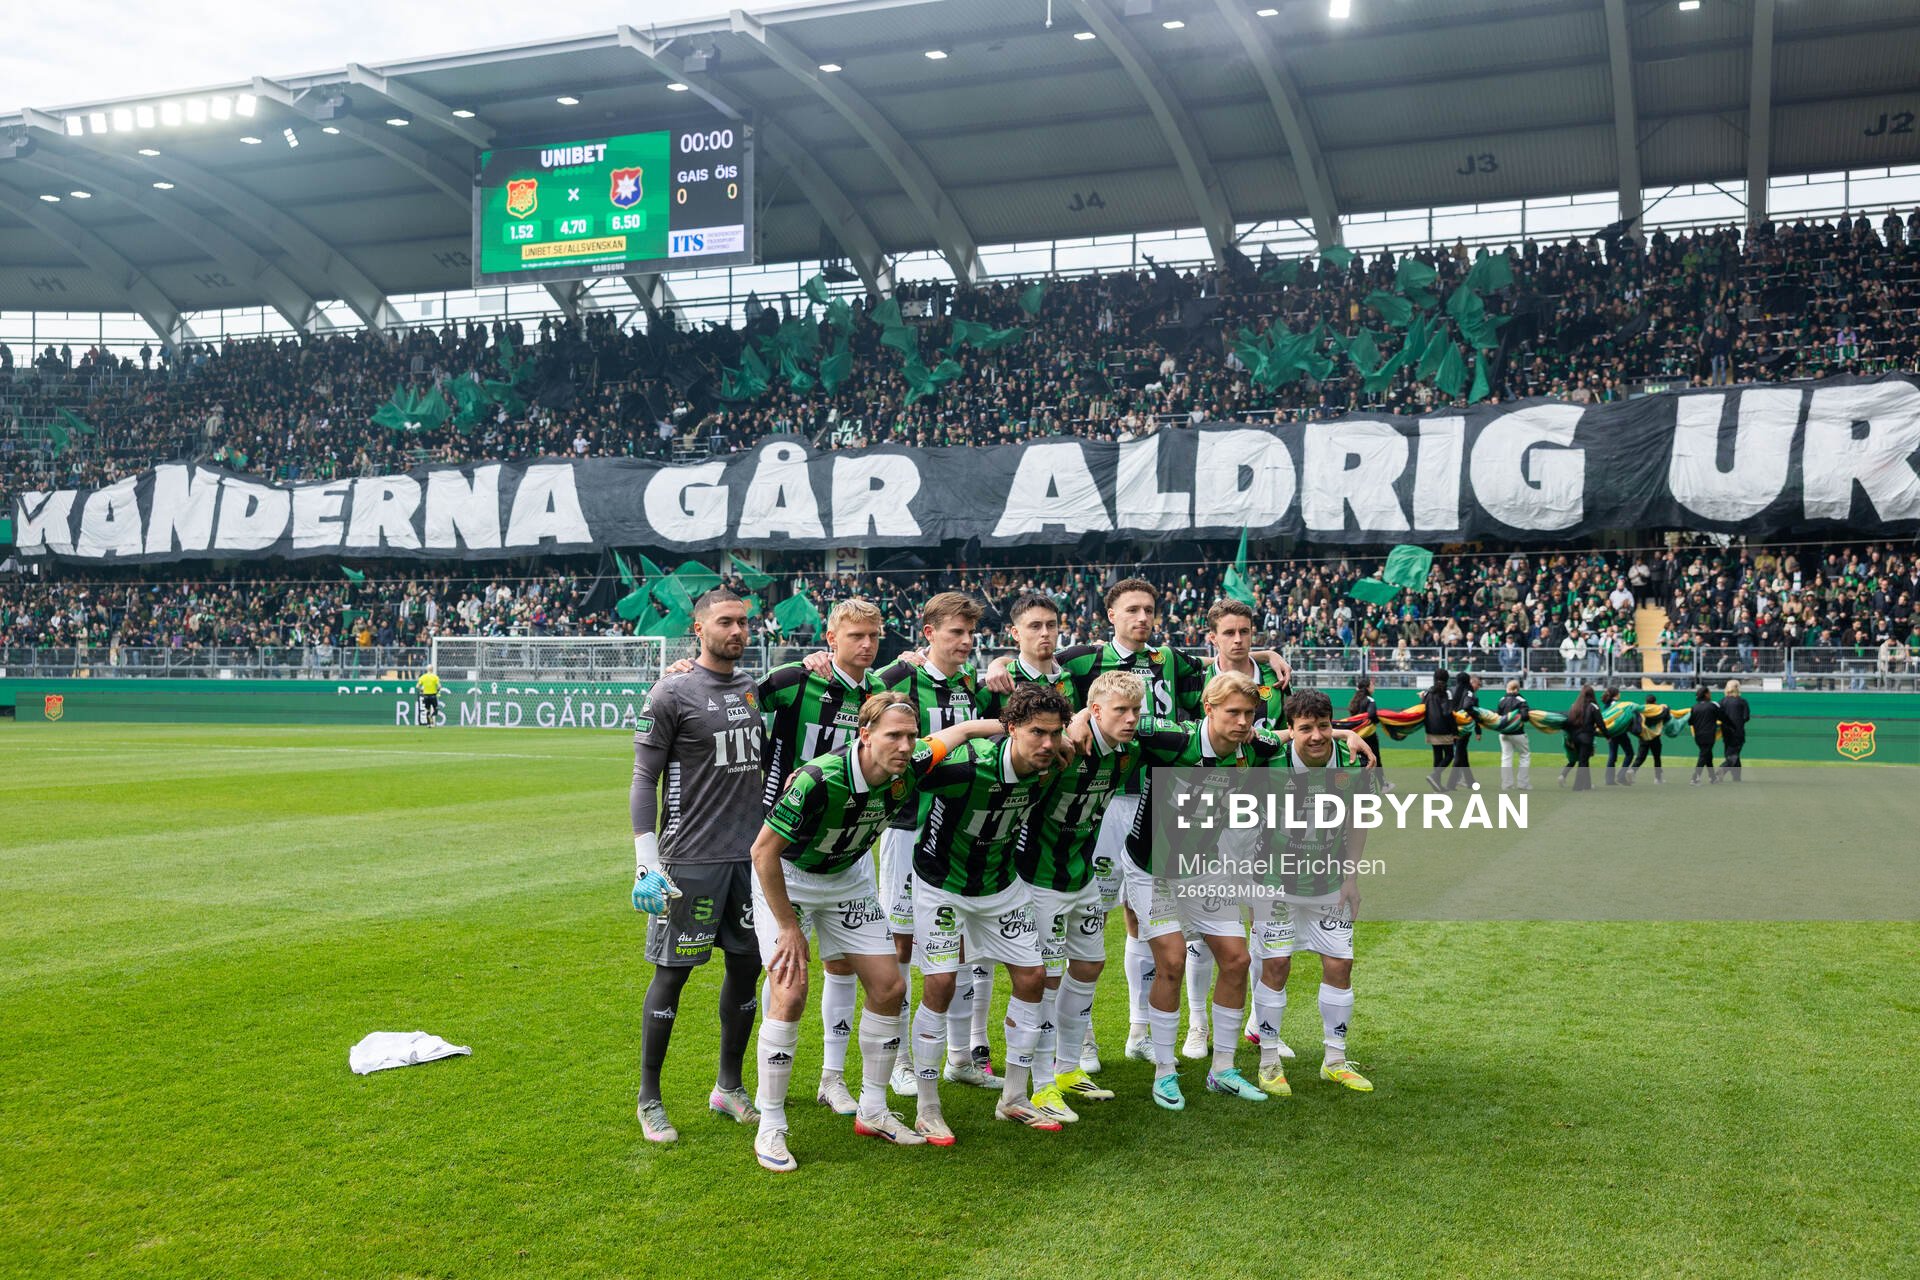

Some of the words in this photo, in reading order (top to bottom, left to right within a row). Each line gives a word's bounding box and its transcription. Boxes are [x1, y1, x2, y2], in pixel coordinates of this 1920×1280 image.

[1863, 112, 1914, 137] J2
[680, 130, 733, 153] 00:00
[541, 144, 607, 167] UNIBET
[1456, 153, 1500, 176] J3
[677, 168, 709, 183] GAIS
[714, 165, 738, 180] ÖIS
[676, 188, 688, 204] 0
[726, 183, 738, 200] 0
[1069, 193, 1107, 212] J4
[509, 225, 535, 240] 1.52
[559, 219, 587, 235] 4.70
[612, 214, 641, 230] 6.50
[524, 240, 625, 256] UNIBET.SE/ALLSVENSKAN
[673, 233, 704, 253] ITS
[643, 441, 922, 541] GÅR
[991, 405, 1585, 538] ALDRIG
[951, 694, 969, 702] SKAB
[460, 701, 523, 727] MED
[728, 708, 748, 718] SKAB
[836, 713, 859, 723] SKAB
